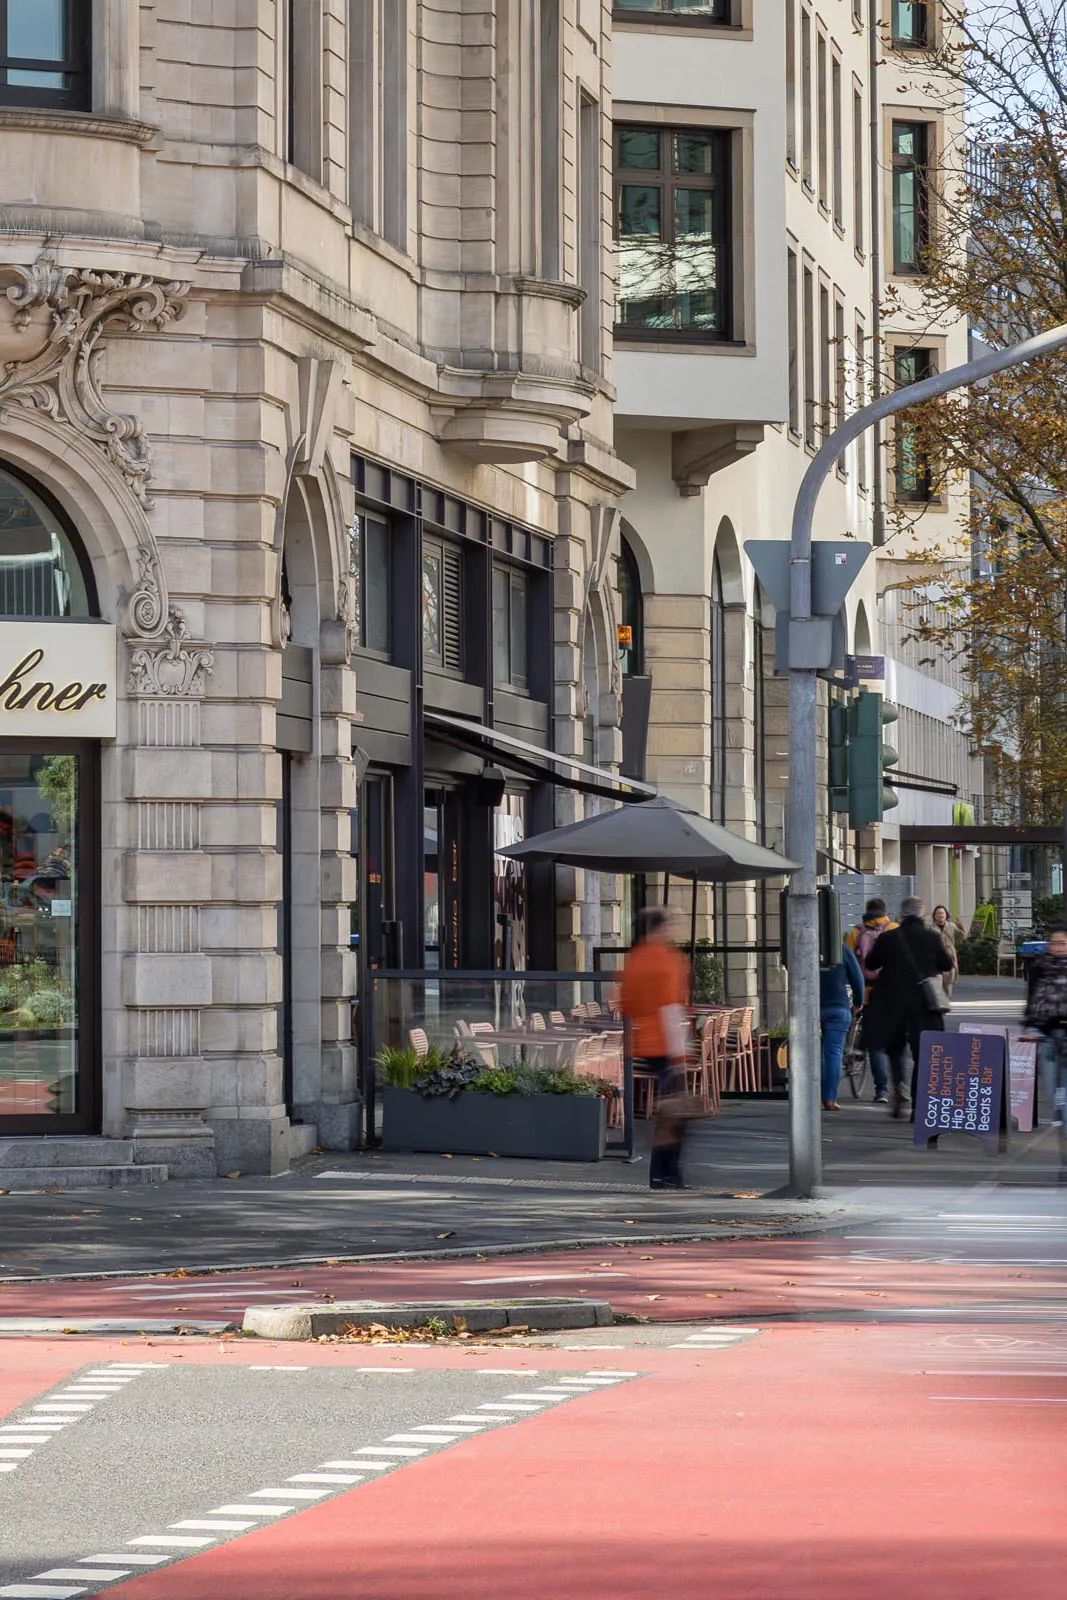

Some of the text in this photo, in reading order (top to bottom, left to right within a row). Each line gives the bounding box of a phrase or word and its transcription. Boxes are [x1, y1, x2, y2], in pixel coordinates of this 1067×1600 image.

[925, 1045, 943, 1127] Cozy Morning
[968, 1037, 981, 1075] Dinner
[938, 1056, 954, 1128] Long Brunch
[952, 1072, 965, 1129] Hip Lunch
[965, 1077, 979, 1130] Delicious
[978, 1066, 993, 1131] Beats & Bar
